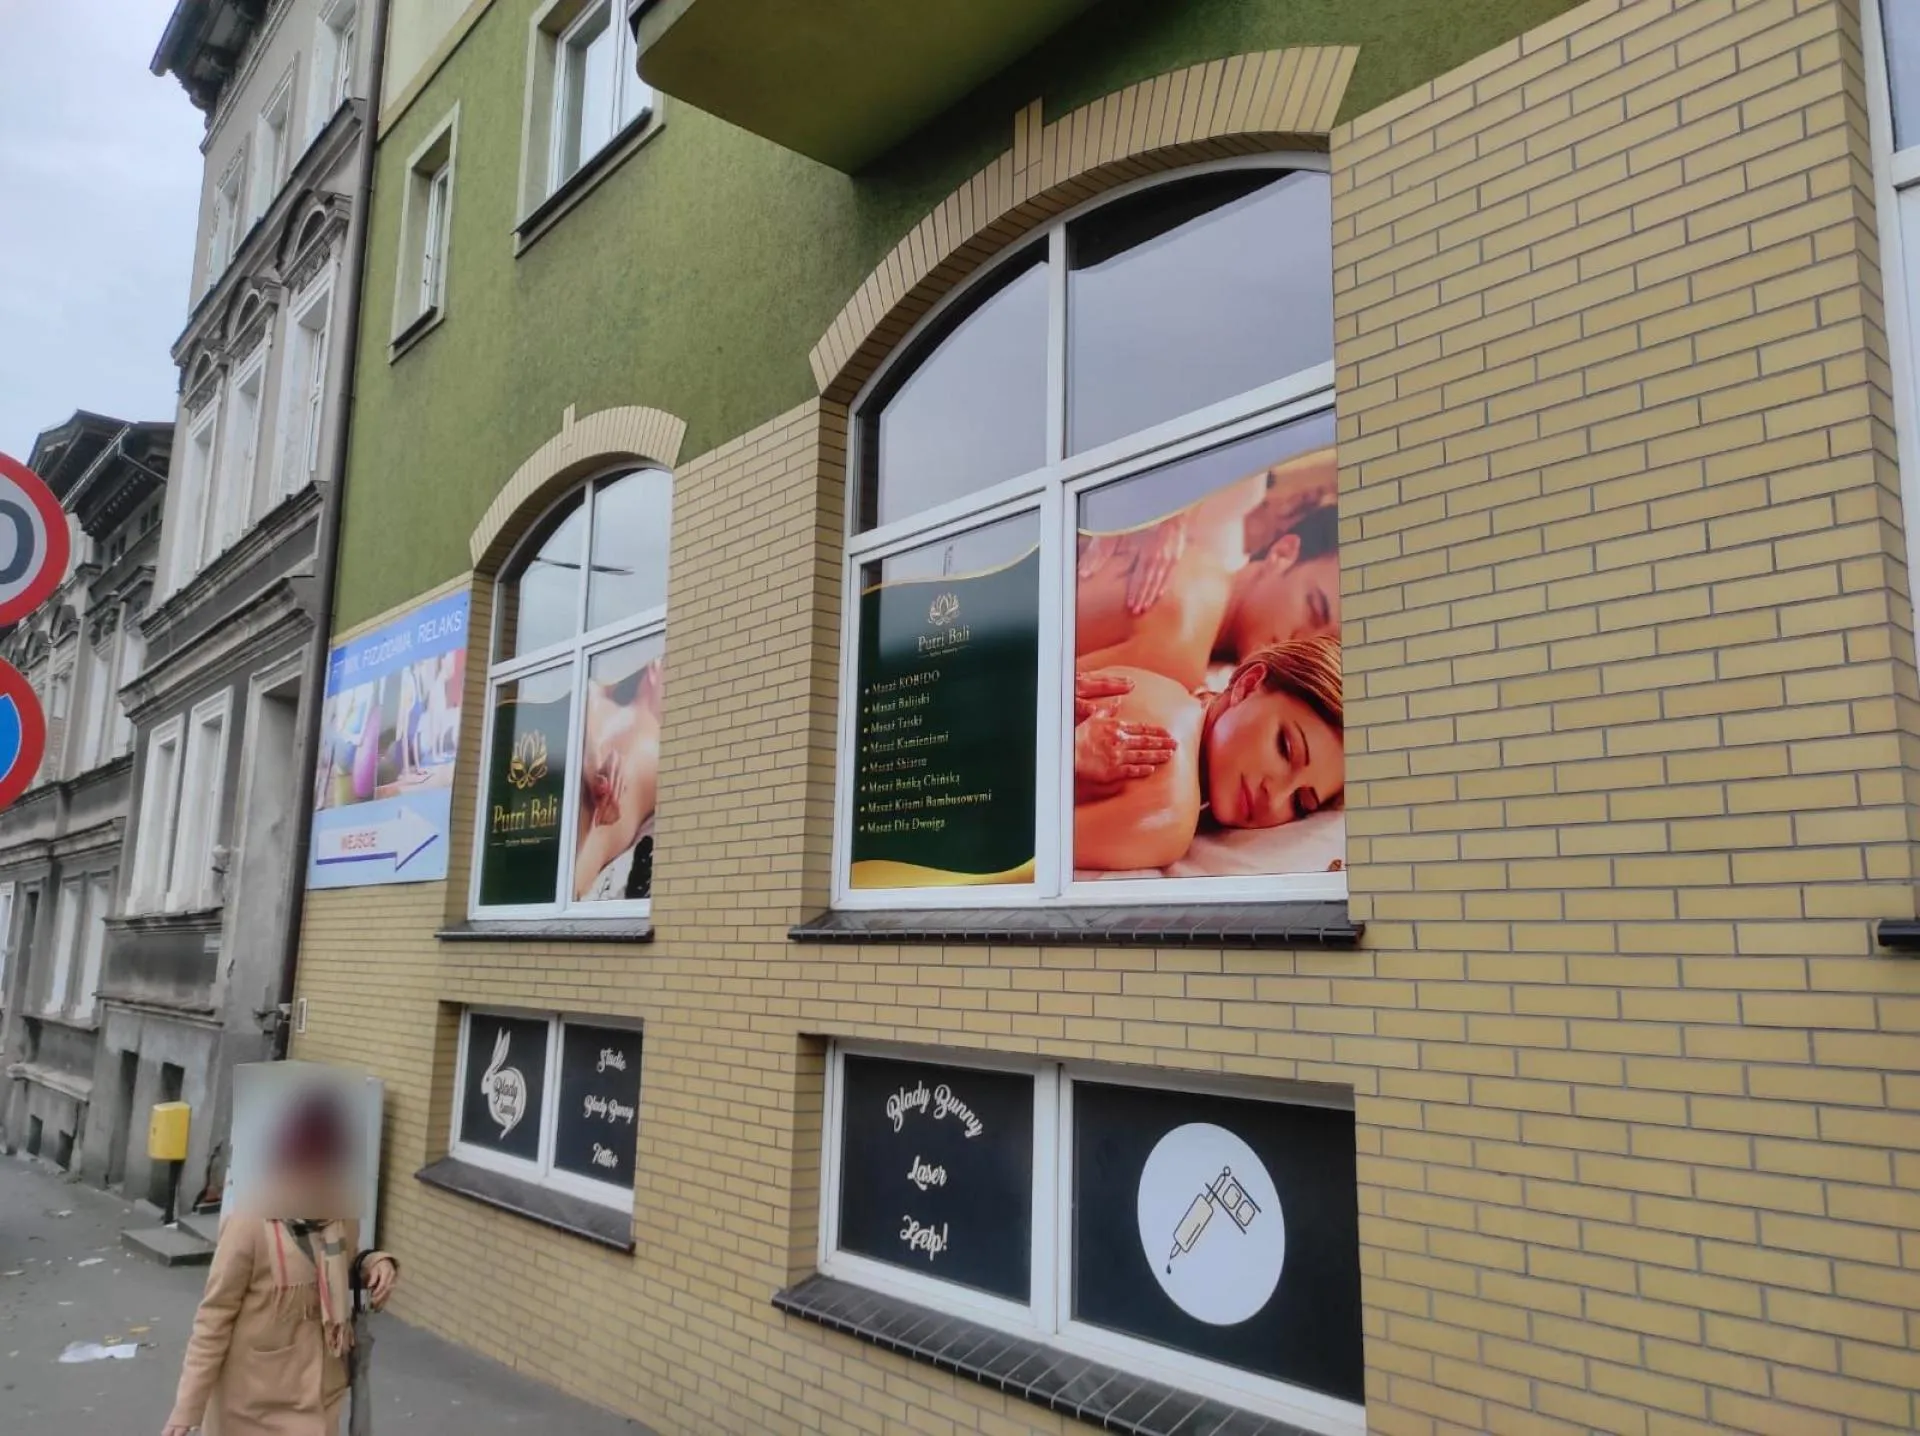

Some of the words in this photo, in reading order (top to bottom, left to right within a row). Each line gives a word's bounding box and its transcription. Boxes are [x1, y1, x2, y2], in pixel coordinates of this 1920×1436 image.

[417, 610, 462, 643] RELAKS
[948, 624, 971, 645] Bali
[492, 803, 526, 834] Putri
[530, 794, 558, 828] Bali
[925, 788, 992, 808] Bambusowymi
[887, 1080, 931, 1133] Blady
[933, 1084, 984, 1138] Bunny
[907, 1155, 948, 1191] Laser
[900, 1215, 949, 1262] Help!
